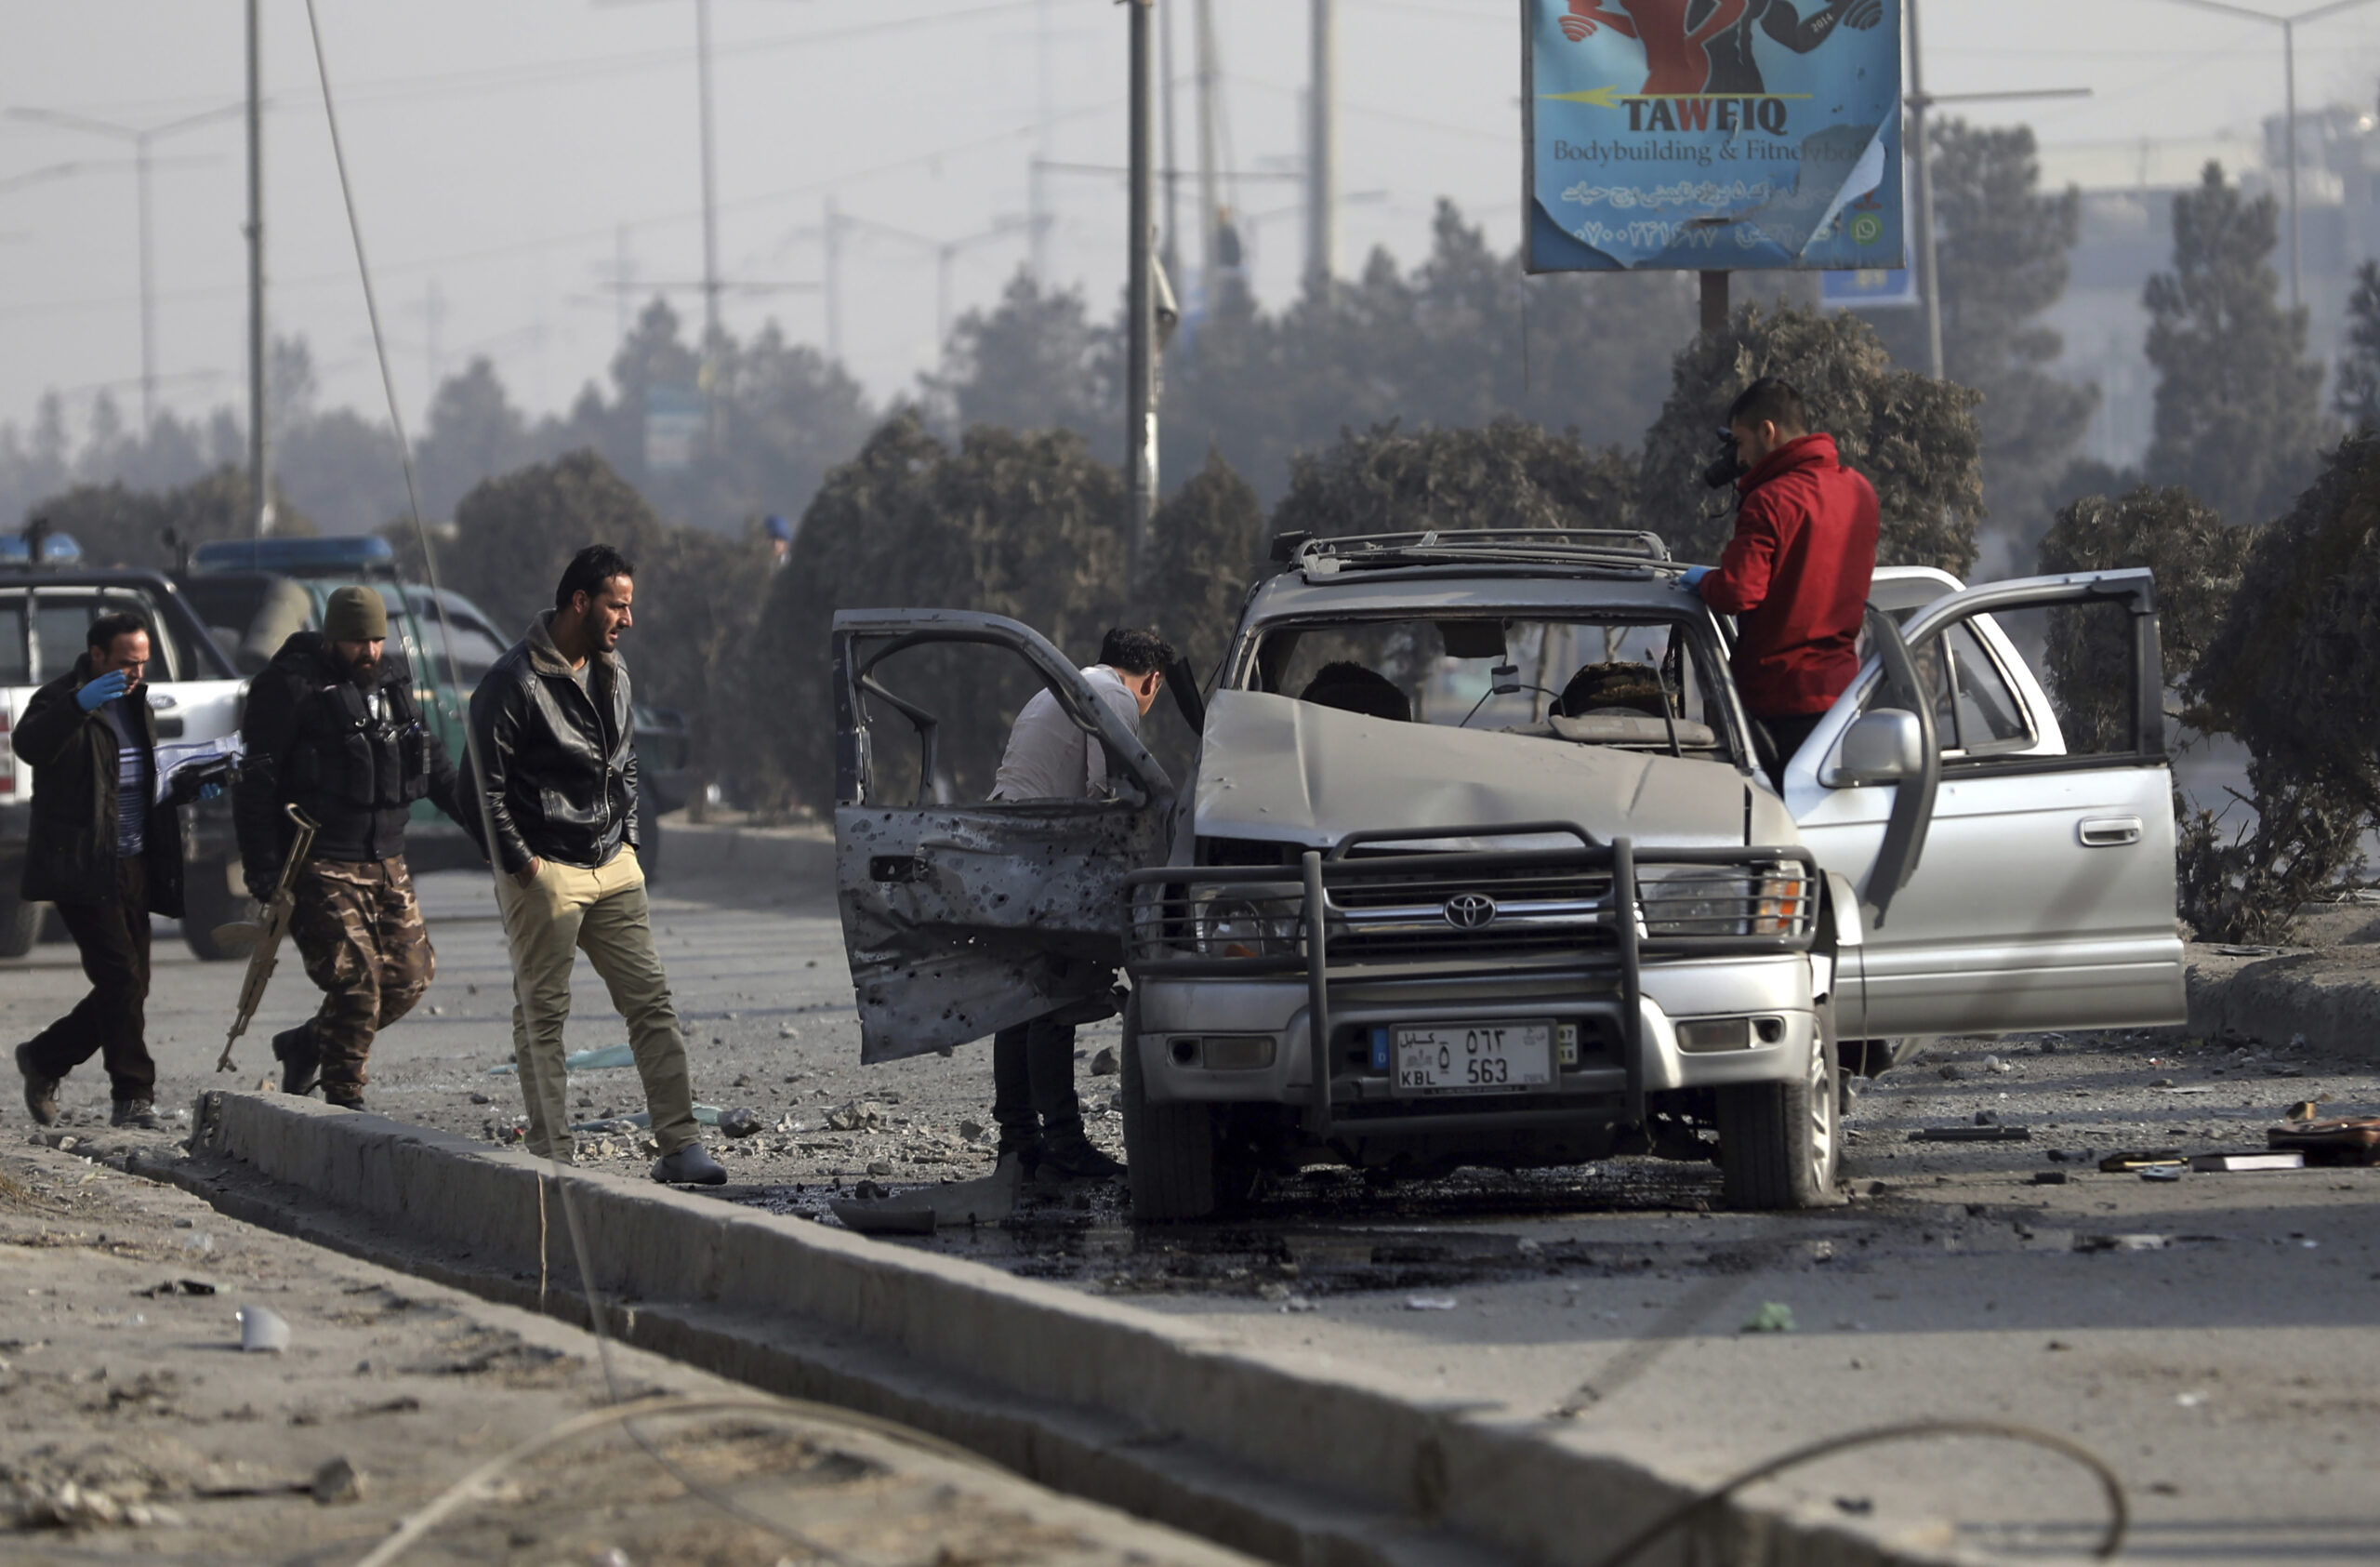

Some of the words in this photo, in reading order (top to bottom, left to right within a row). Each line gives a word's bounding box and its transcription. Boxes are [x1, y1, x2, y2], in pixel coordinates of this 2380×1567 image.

[1621, 99, 1789, 136] TAWFIQ
[1554, 139, 1712, 167] Bodybuilding
[1718, 139, 1739, 161] &
[1401, 1070, 1436, 1087] KBL
[1466, 1057, 1508, 1084] 563
